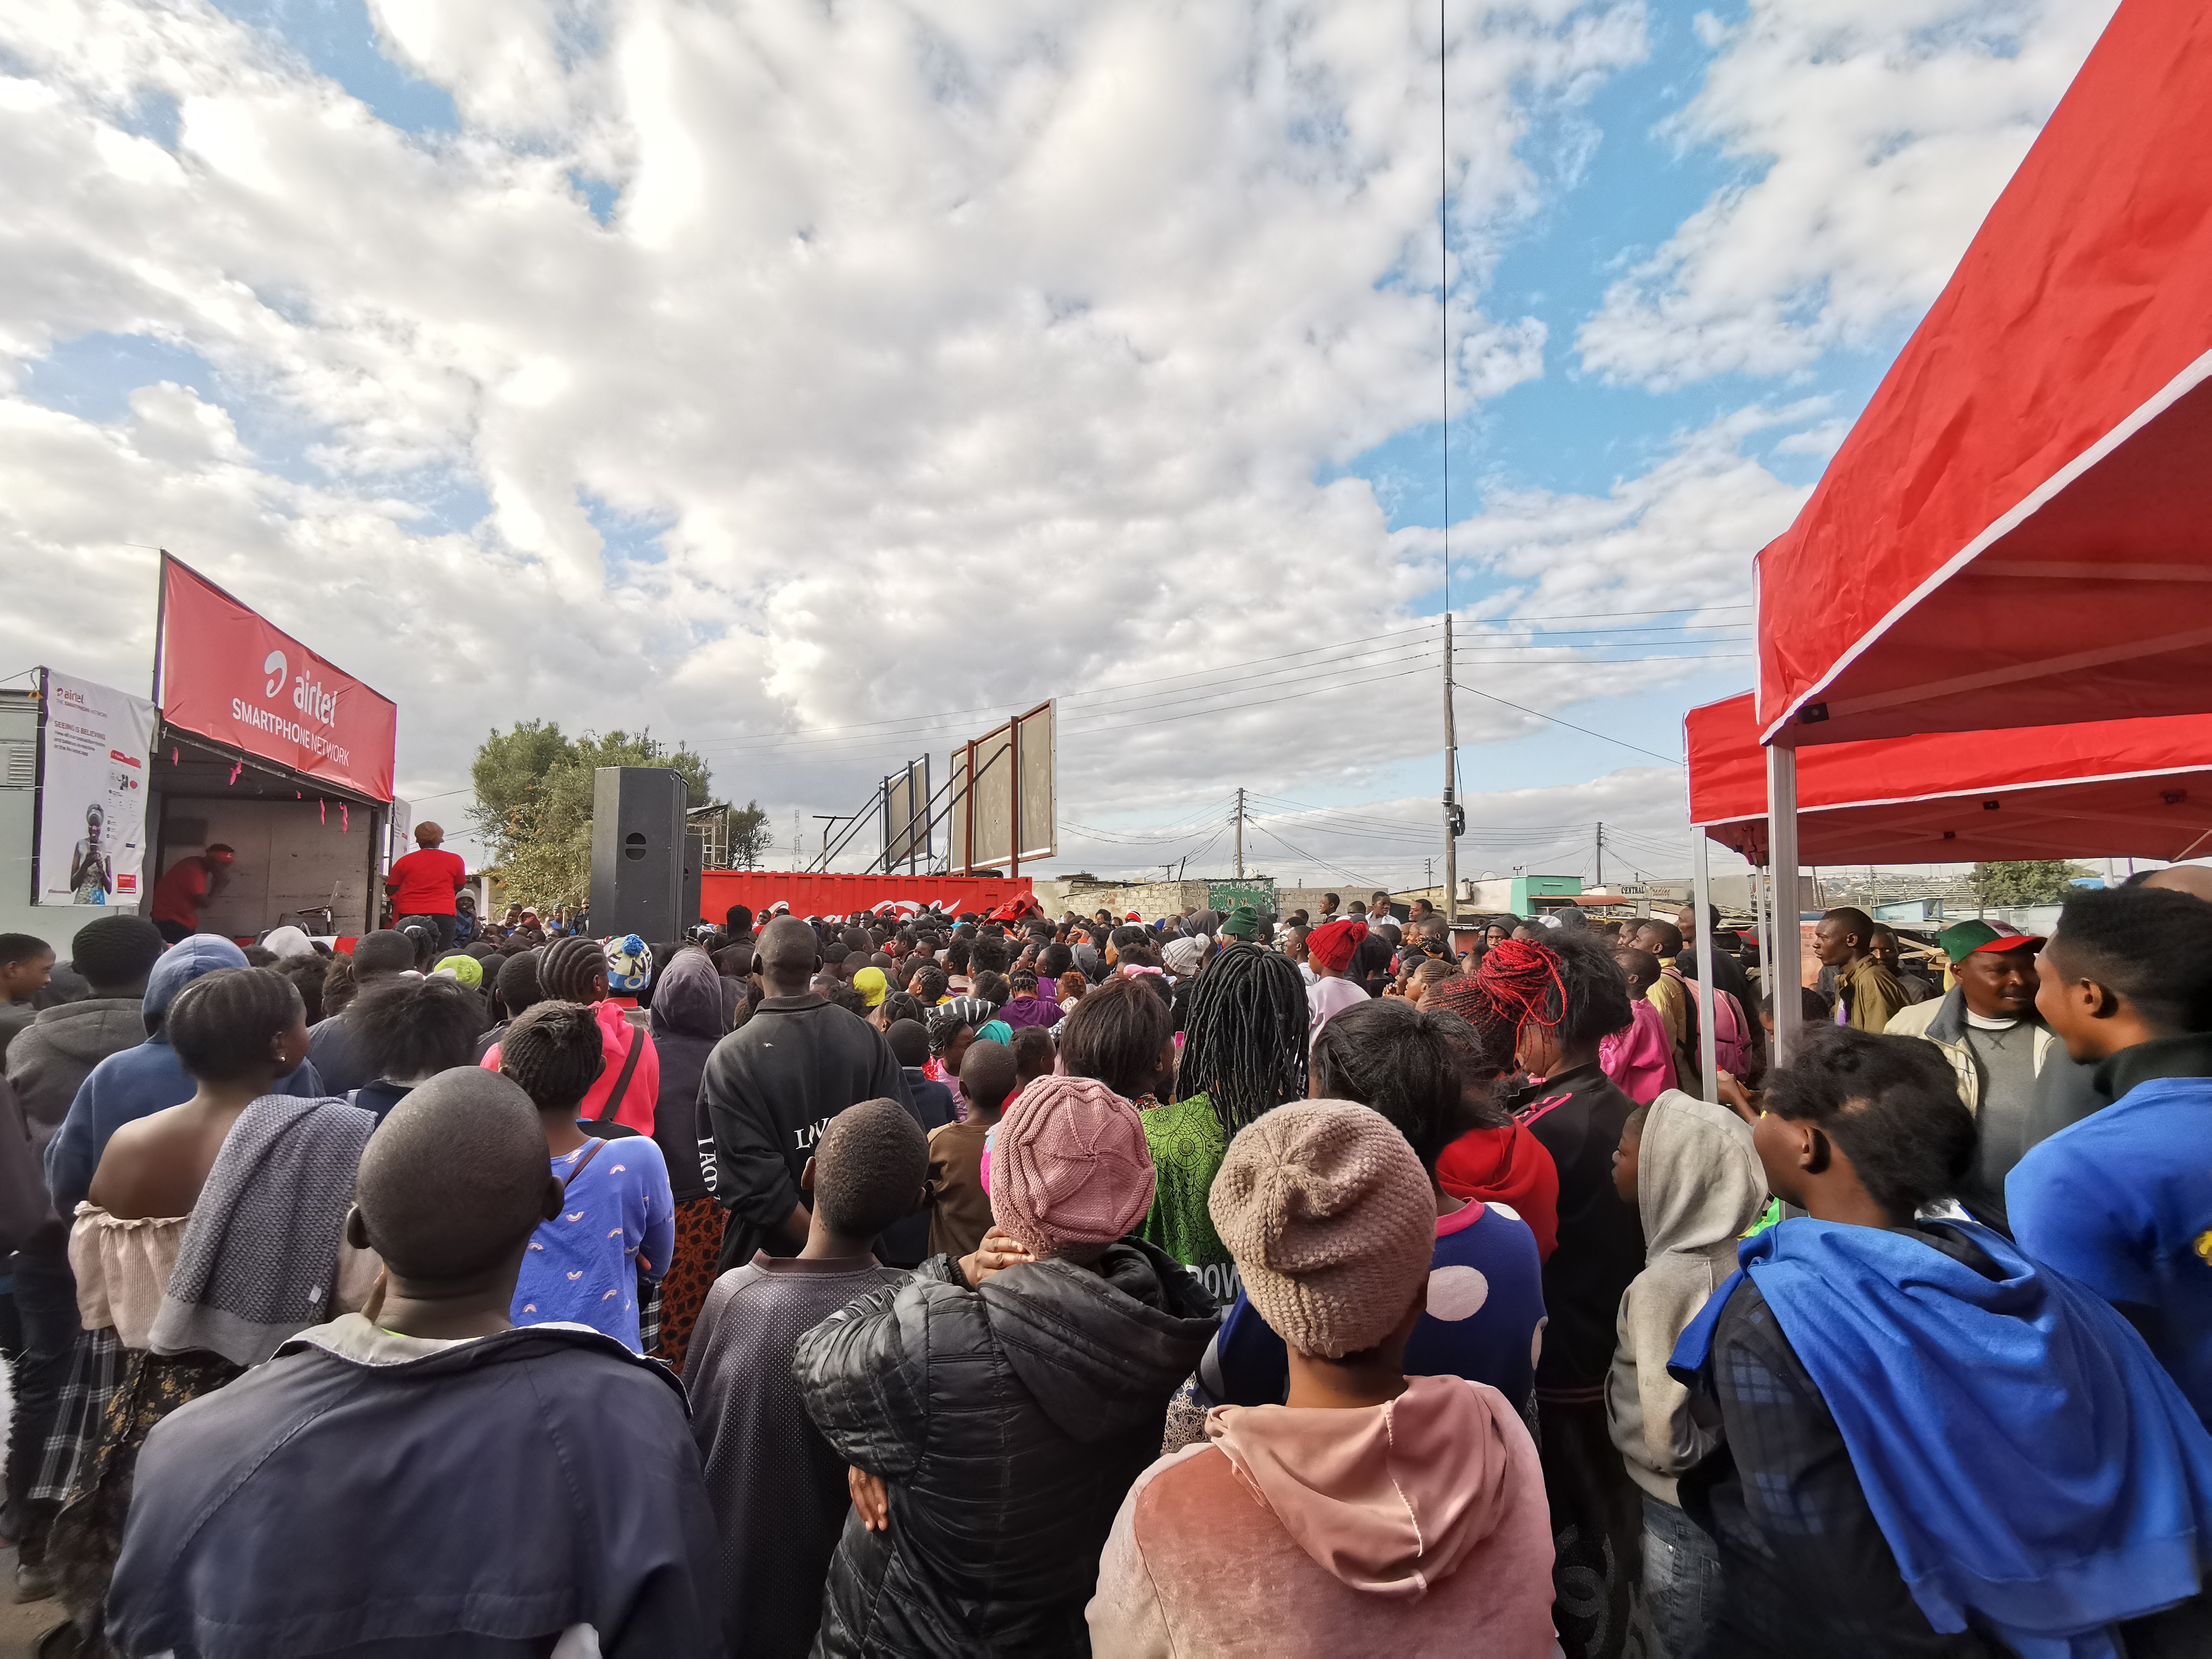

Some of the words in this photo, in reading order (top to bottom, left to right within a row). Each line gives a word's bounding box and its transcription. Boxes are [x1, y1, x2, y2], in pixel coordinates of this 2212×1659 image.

[64, 690, 83, 704] airtel
[294, 670, 338, 728] airtel
[54, 721, 74, 731] SEEING
[232, 698, 310, 749] SMARTPHONE
[311, 733, 350, 767] NETWORK
[794, 1116, 837, 1150] LOV
